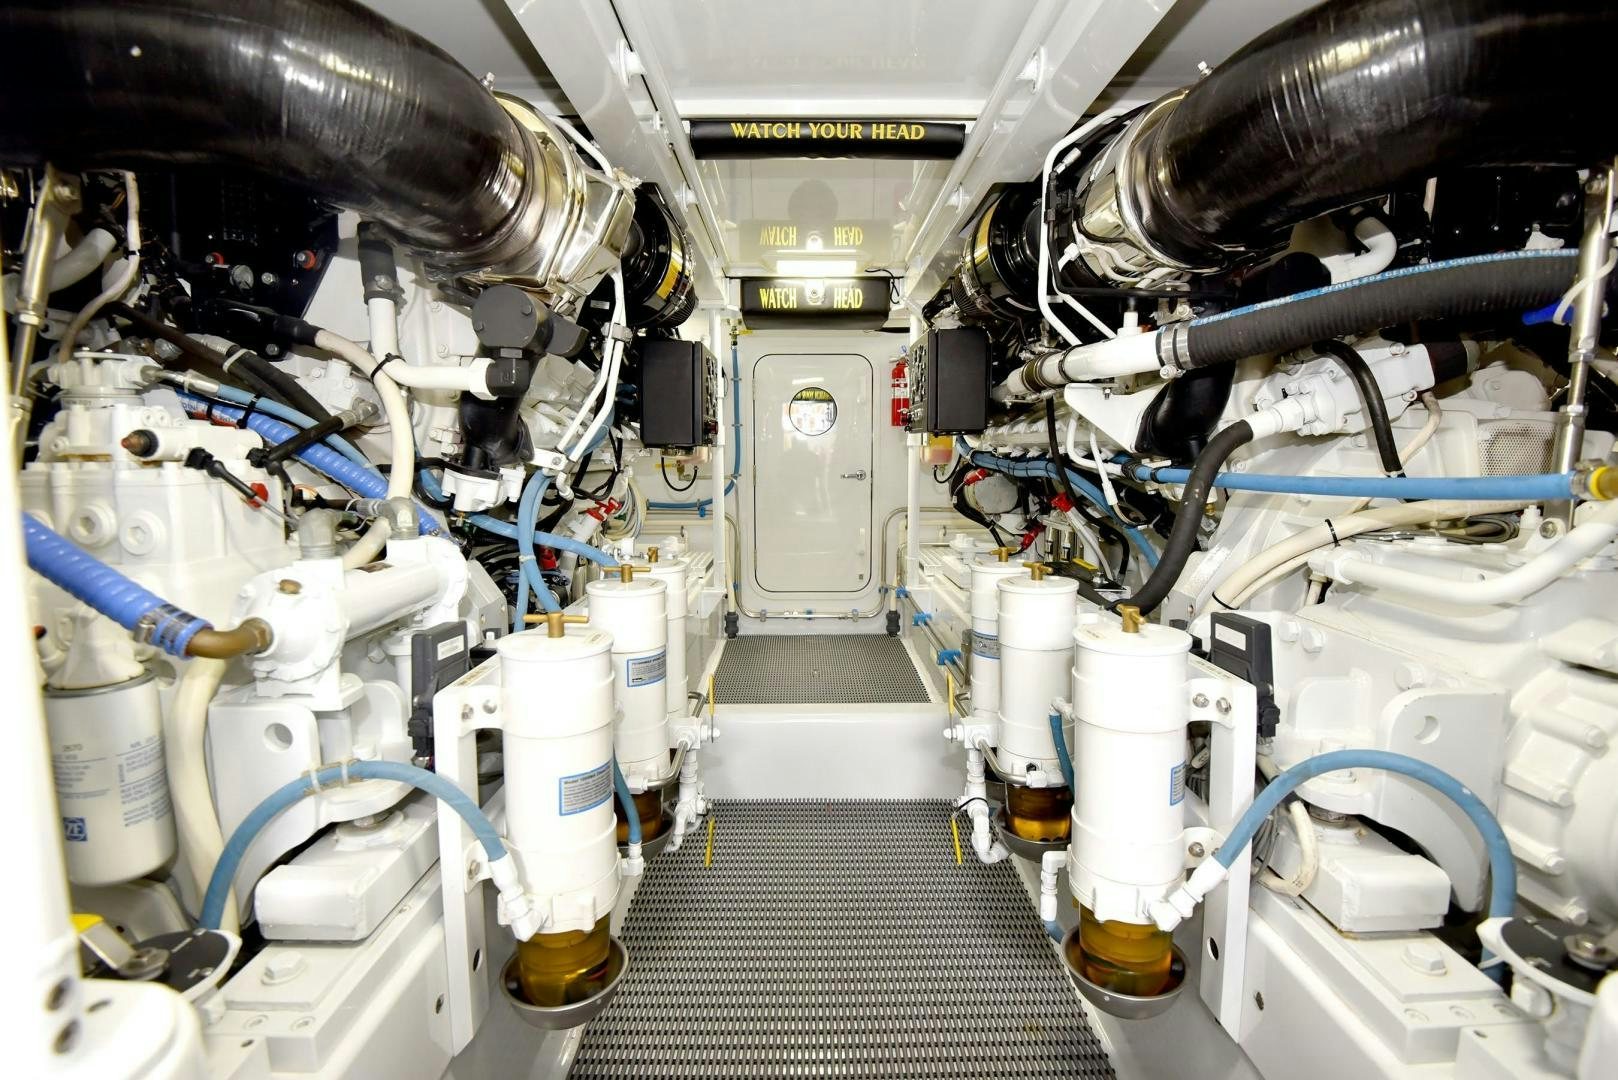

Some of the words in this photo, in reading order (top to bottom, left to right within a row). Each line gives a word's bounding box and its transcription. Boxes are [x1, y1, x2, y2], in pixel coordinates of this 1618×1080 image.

[730, 122, 800, 139] WATCH
[808, 122, 863, 139] YOUR
[871, 123, 926, 140] HEAD
[1384, 261, 1446, 278] CERTIFIED
[759, 287, 798, 309] WATCH
[833, 287, 864, 309] HEAD
